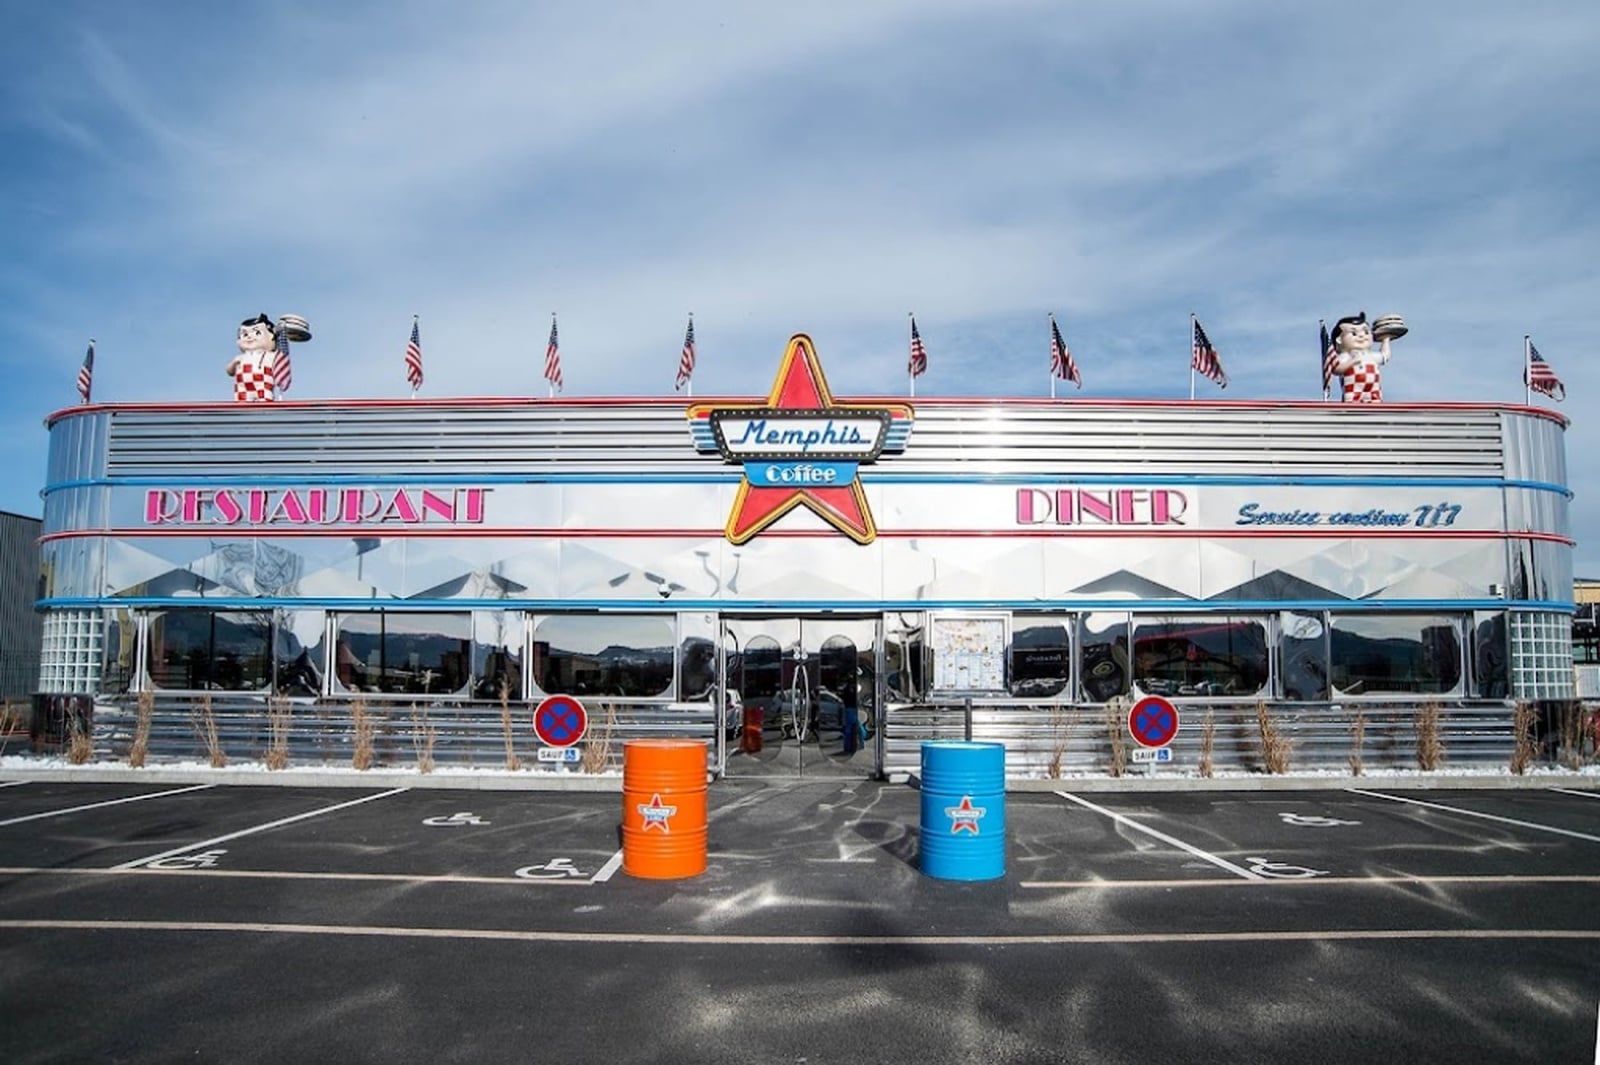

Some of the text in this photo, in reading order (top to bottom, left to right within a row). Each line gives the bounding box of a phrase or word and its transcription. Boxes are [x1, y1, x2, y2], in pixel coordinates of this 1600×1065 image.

[729, 419, 872, 453] Memphis
[765, 464, 837, 484] Coffee
[145, 487, 494, 525] RESTAURANT
[1016, 488, 1188, 525] DINER
[1235, 503, 1321, 526] Service
